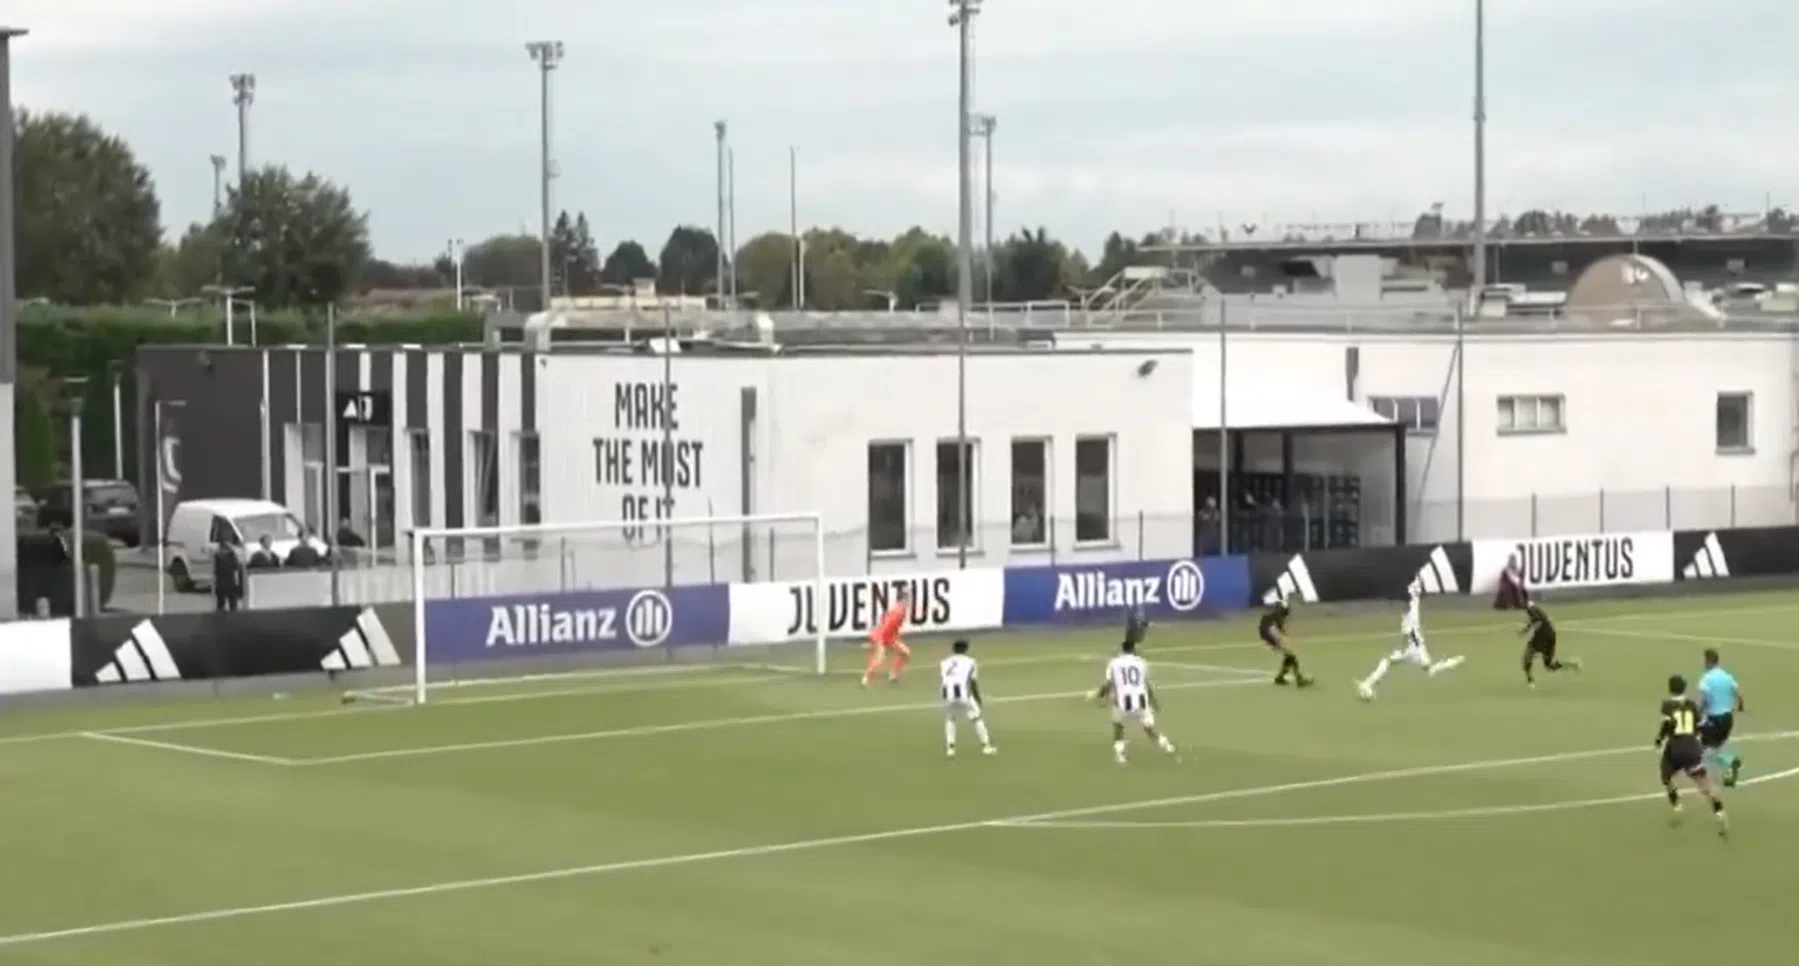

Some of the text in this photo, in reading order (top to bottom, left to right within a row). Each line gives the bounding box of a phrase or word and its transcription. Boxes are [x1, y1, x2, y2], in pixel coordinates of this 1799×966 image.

[614, 382, 679, 430] MAKE
[592, 437, 703, 488] THE MOST
[1054, 571, 1161, 611] Allianz
[486, 603, 617, 647] Allianz
[1120, 665, 1141, 687] 10
